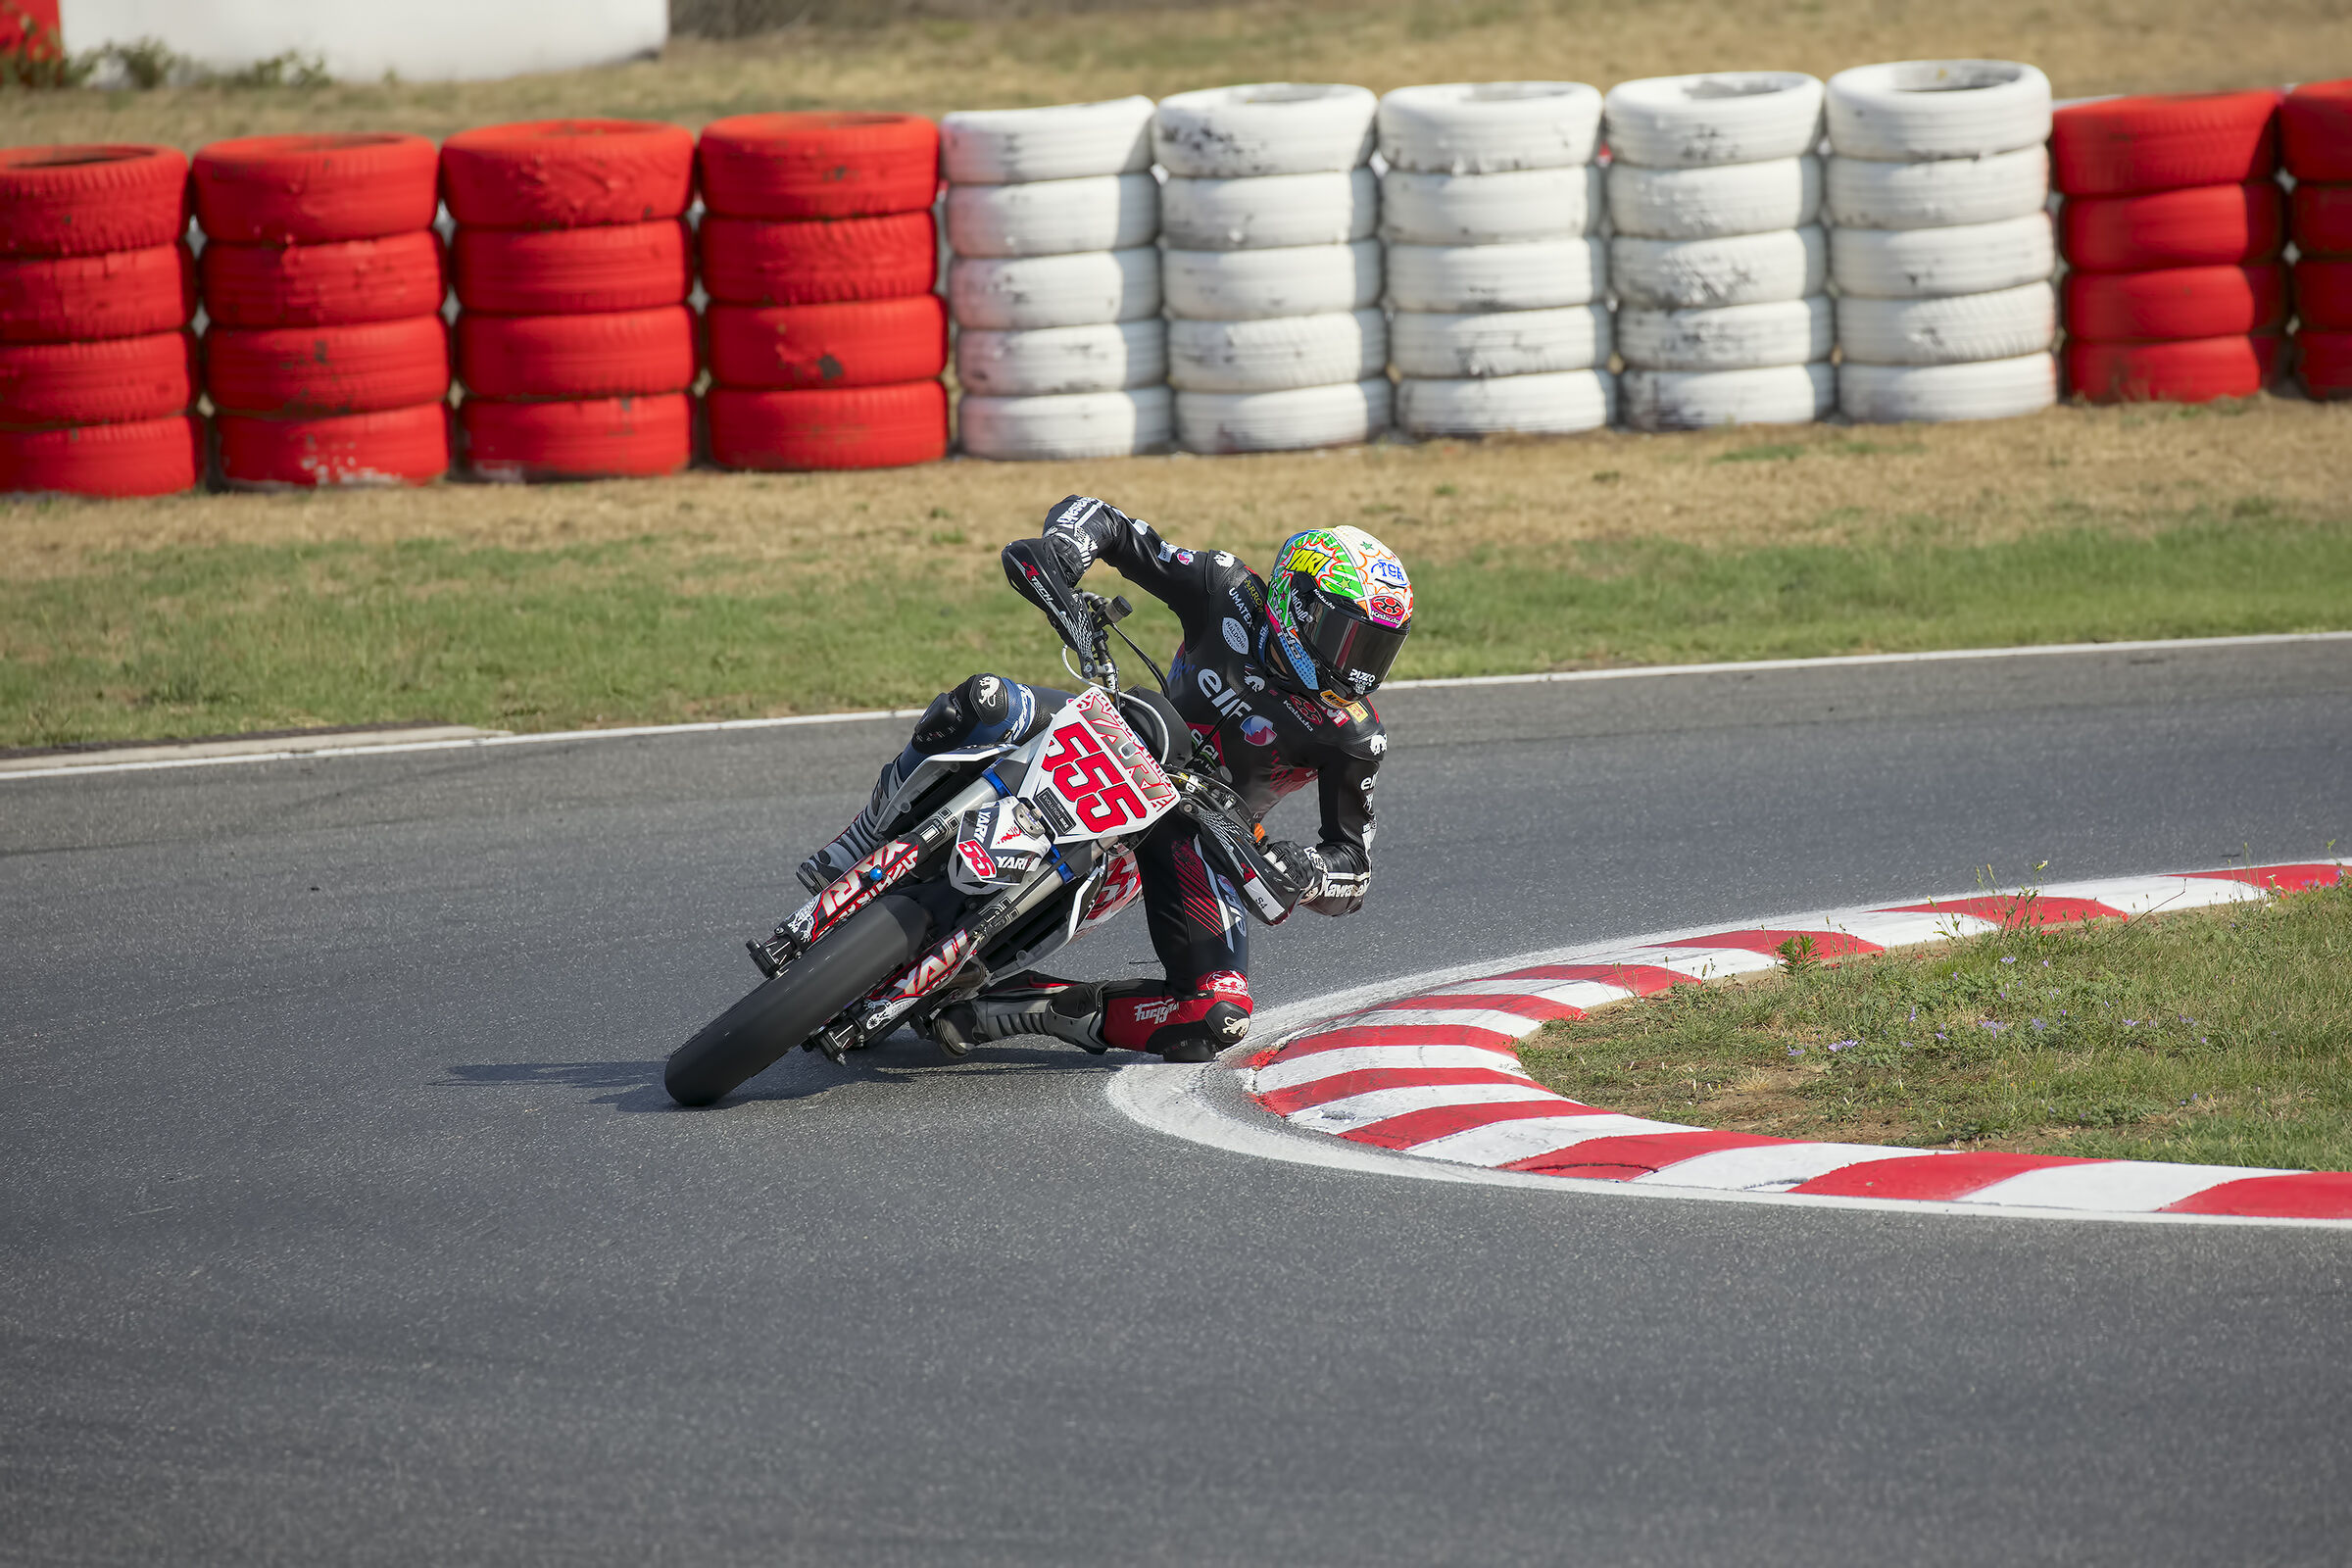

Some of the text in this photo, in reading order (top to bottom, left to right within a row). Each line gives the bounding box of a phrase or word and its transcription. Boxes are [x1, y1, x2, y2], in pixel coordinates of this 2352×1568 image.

[1285, 548, 1332, 577] YARI
[1228, 587, 1253, 631] UMATEX
[1371, 611, 1400, 625] Kabuto
[1348, 668, 1376, 683] PIZZO
[1198, 668, 1252, 720] elf
[1283, 700, 1313, 732] Kabuto
[1079, 696, 1171, 801] YARI
[1041, 721, 1148, 833] 555
[973, 811, 991, 844] YARI
[957, 840, 996, 877] 55
[996, 856, 1029, 870] YARI
[1255, 897, 1268, 909] S4
